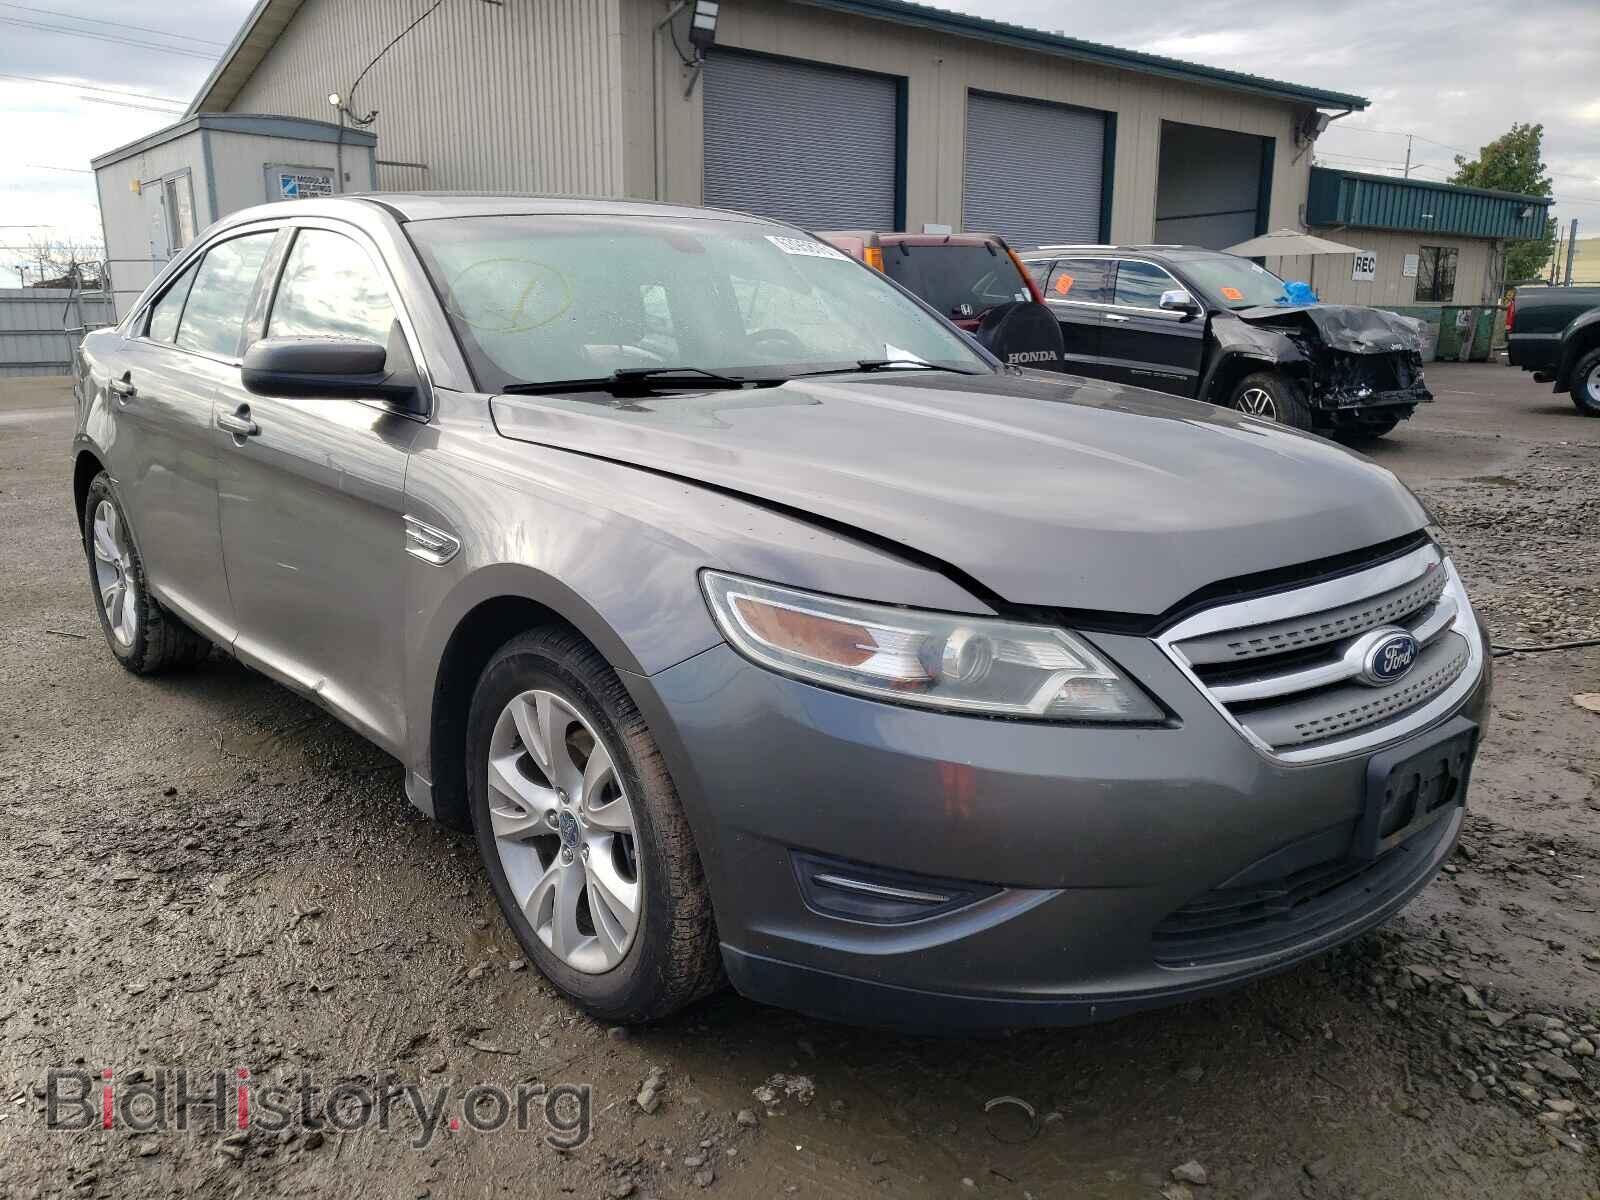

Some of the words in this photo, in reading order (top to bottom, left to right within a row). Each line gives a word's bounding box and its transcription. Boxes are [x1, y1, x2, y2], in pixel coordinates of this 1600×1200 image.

[297, 176, 330, 184] MODULAR
[1355, 256, 1375, 274] REC
[1008, 351, 1058, 364] HONDA
[1384, 641, 1414, 672] Ford
